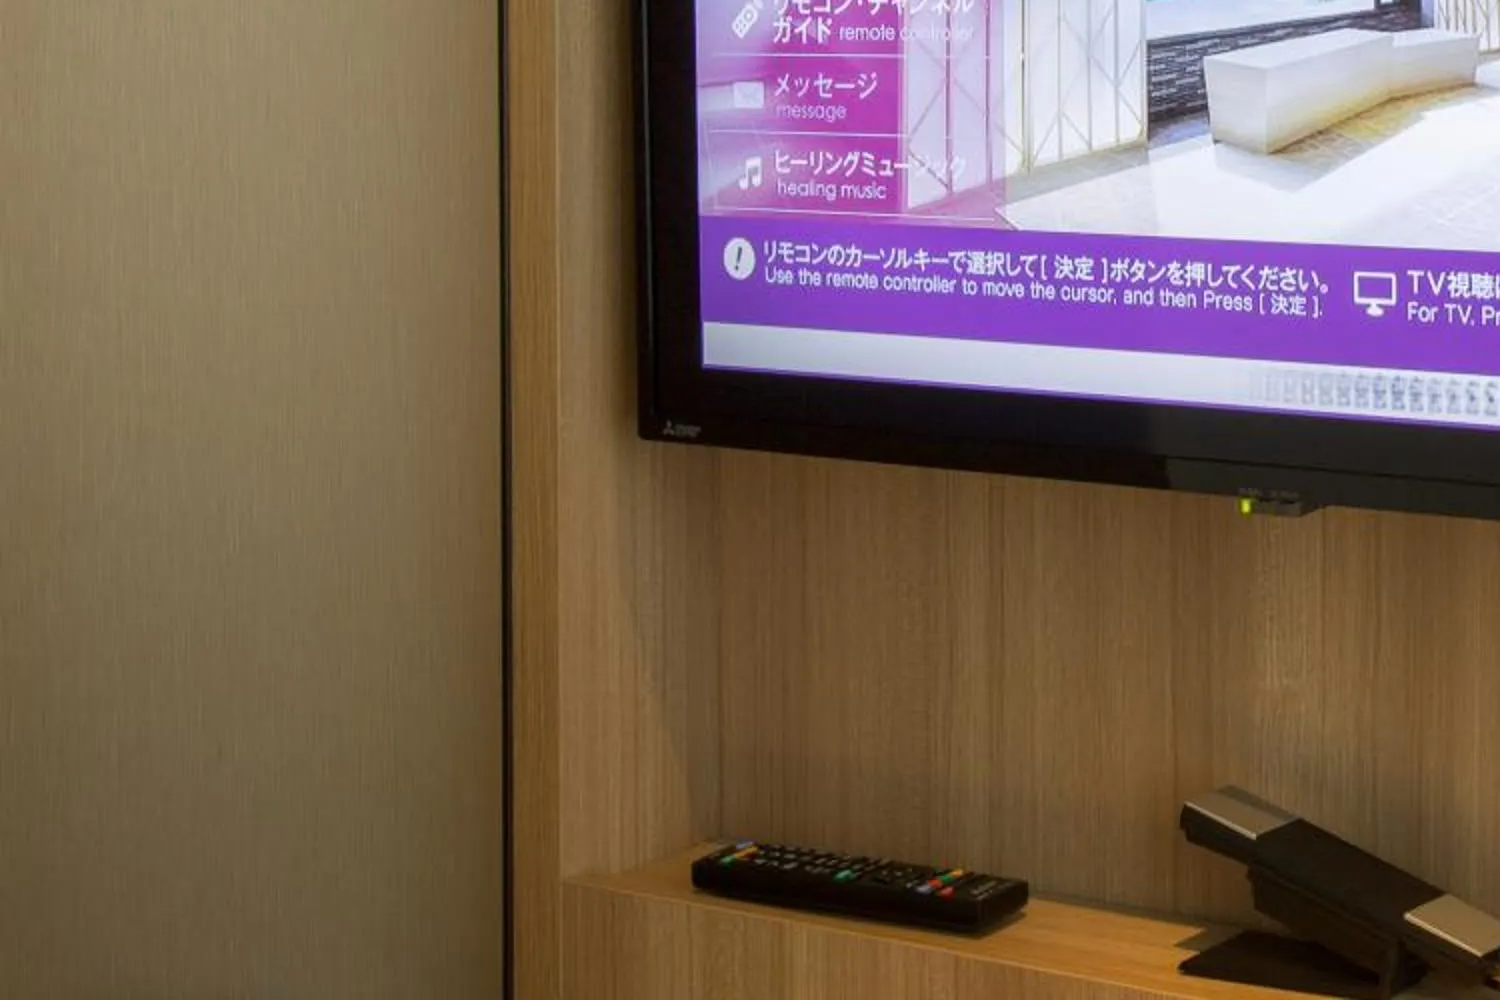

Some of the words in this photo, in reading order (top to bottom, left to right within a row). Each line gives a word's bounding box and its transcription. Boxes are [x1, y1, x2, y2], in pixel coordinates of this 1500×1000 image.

[773, 17, 833, 44] ガイド
[839, 23, 897, 42] remote
[774, 71, 879, 100] メッセージ
[775, 103, 847, 123] message
[776, 176, 836, 201] healing
[840, 179, 888, 200] music
[764, 266, 794, 284] Use
[797, 267, 822, 286] the
[825, 271, 879, 289] remote
[882, 272, 957, 294] controller
[962, 275, 978, 295] to
[982, 279, 1025, 298] move
[1029, 279, 1056, 300] the
[1122, 287, 1155, 306] and
[1159, 287, 1198, 309] then
[1202, 289, 1253, 312] Press
[1407, 301, 1438, 323] For
